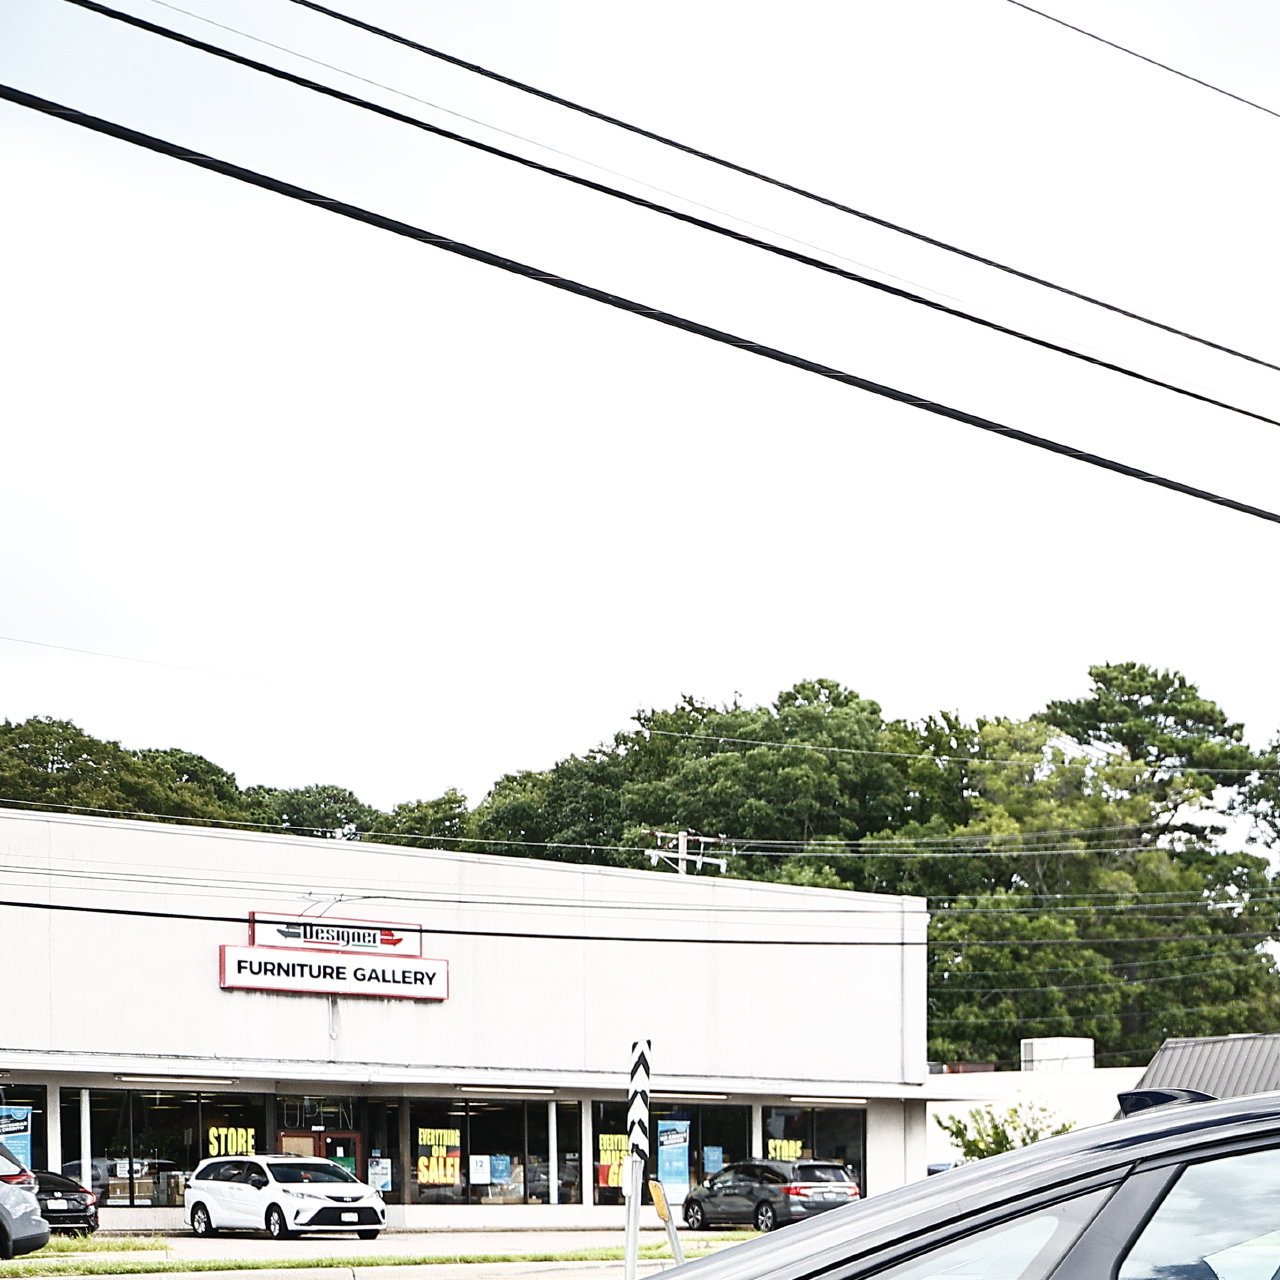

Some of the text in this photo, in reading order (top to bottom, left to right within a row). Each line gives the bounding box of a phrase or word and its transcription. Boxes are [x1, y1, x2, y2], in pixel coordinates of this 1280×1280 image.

[302, 922, 378, 947] Designer
[237, 959, 437, 986] FURNITURE GALLERY
[208, 1126, 256, 1156] STORE
[418, 1128, 460, 1147] EVERYTHING
[431, 1145, 447, 1157] ON
[600, 1150, 629, 1165] MUS
